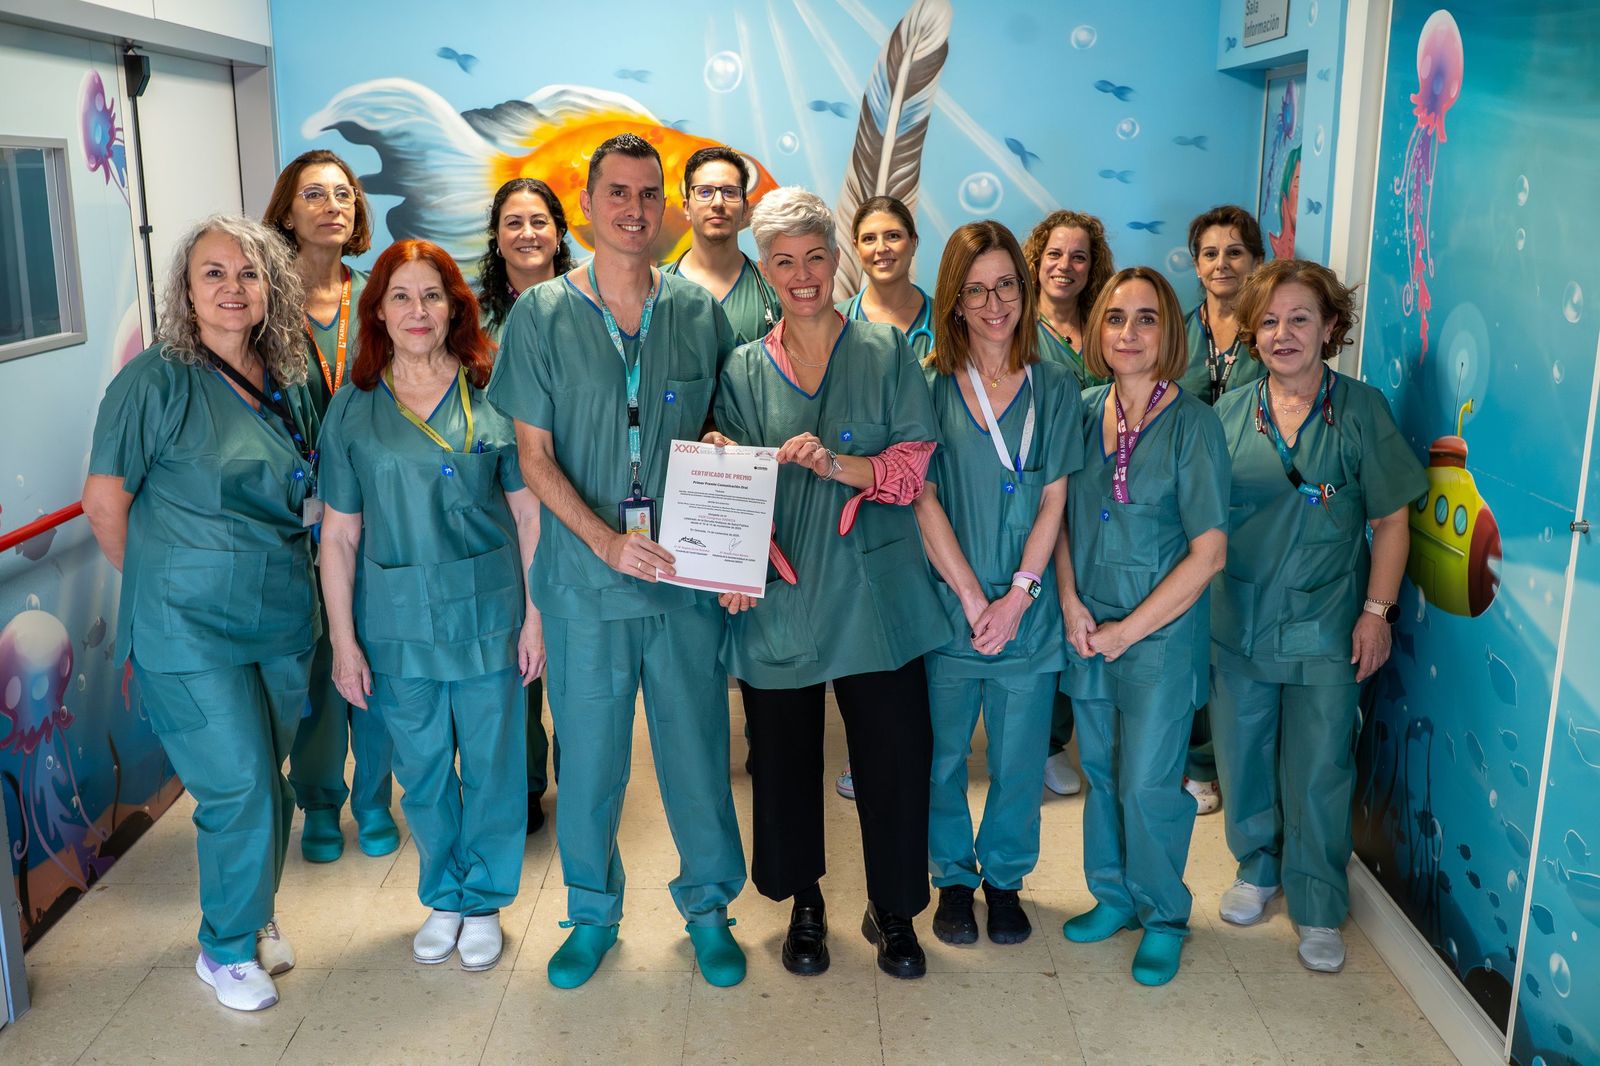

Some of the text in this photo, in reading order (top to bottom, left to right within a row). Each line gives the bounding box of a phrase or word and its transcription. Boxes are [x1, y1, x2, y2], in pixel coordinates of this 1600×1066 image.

[1246, 0, 1259, 16] Sala
[1244, 14, 1279, 38] Información
[338, 319, 346, 340] TARMA
[1151, 389, 1162, 404] CALM
[674, 443, 700, 454] XXIX
[691, 470, 724, 479] CERTIFICADO
[1115, 483, 1123, 500] CALM
